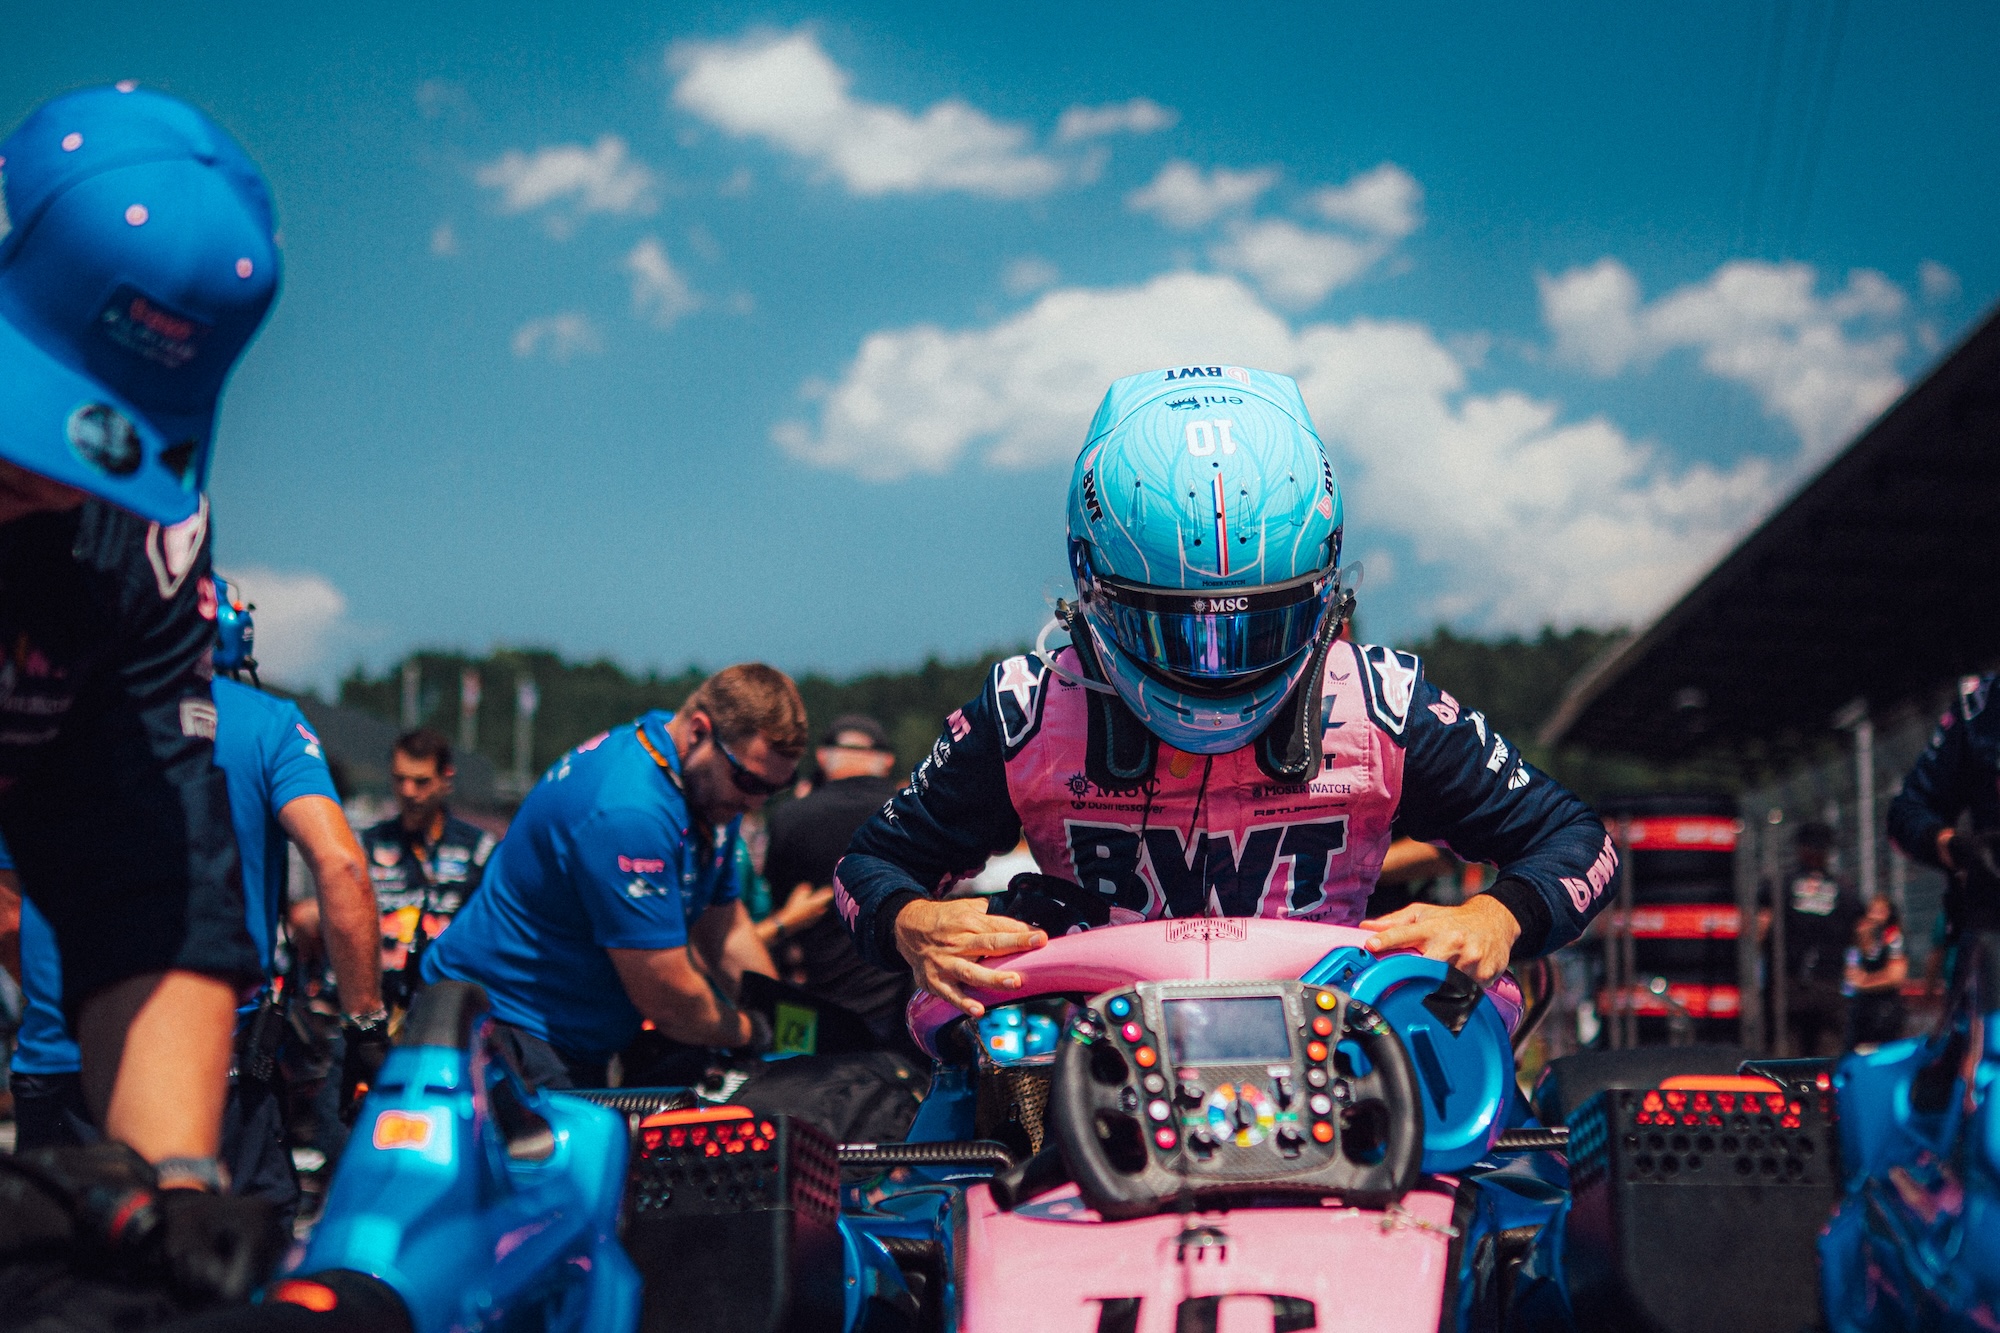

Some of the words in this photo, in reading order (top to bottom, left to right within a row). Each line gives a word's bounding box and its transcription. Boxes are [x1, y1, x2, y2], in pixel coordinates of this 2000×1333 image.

[1165, 366, 1223, 381] BWT
[1204, 395, 1244, 407] eni
[1185, 418, 1238, 457] 10
[1083, 468, 1104, 524] BWT
[1209, 597, 1249, 613] MSC
[1265, 784, 1307, 797] MOSER
[1309, 783, 1351, 795] WATCH
[1064, 814, 1350, 919] BWT
